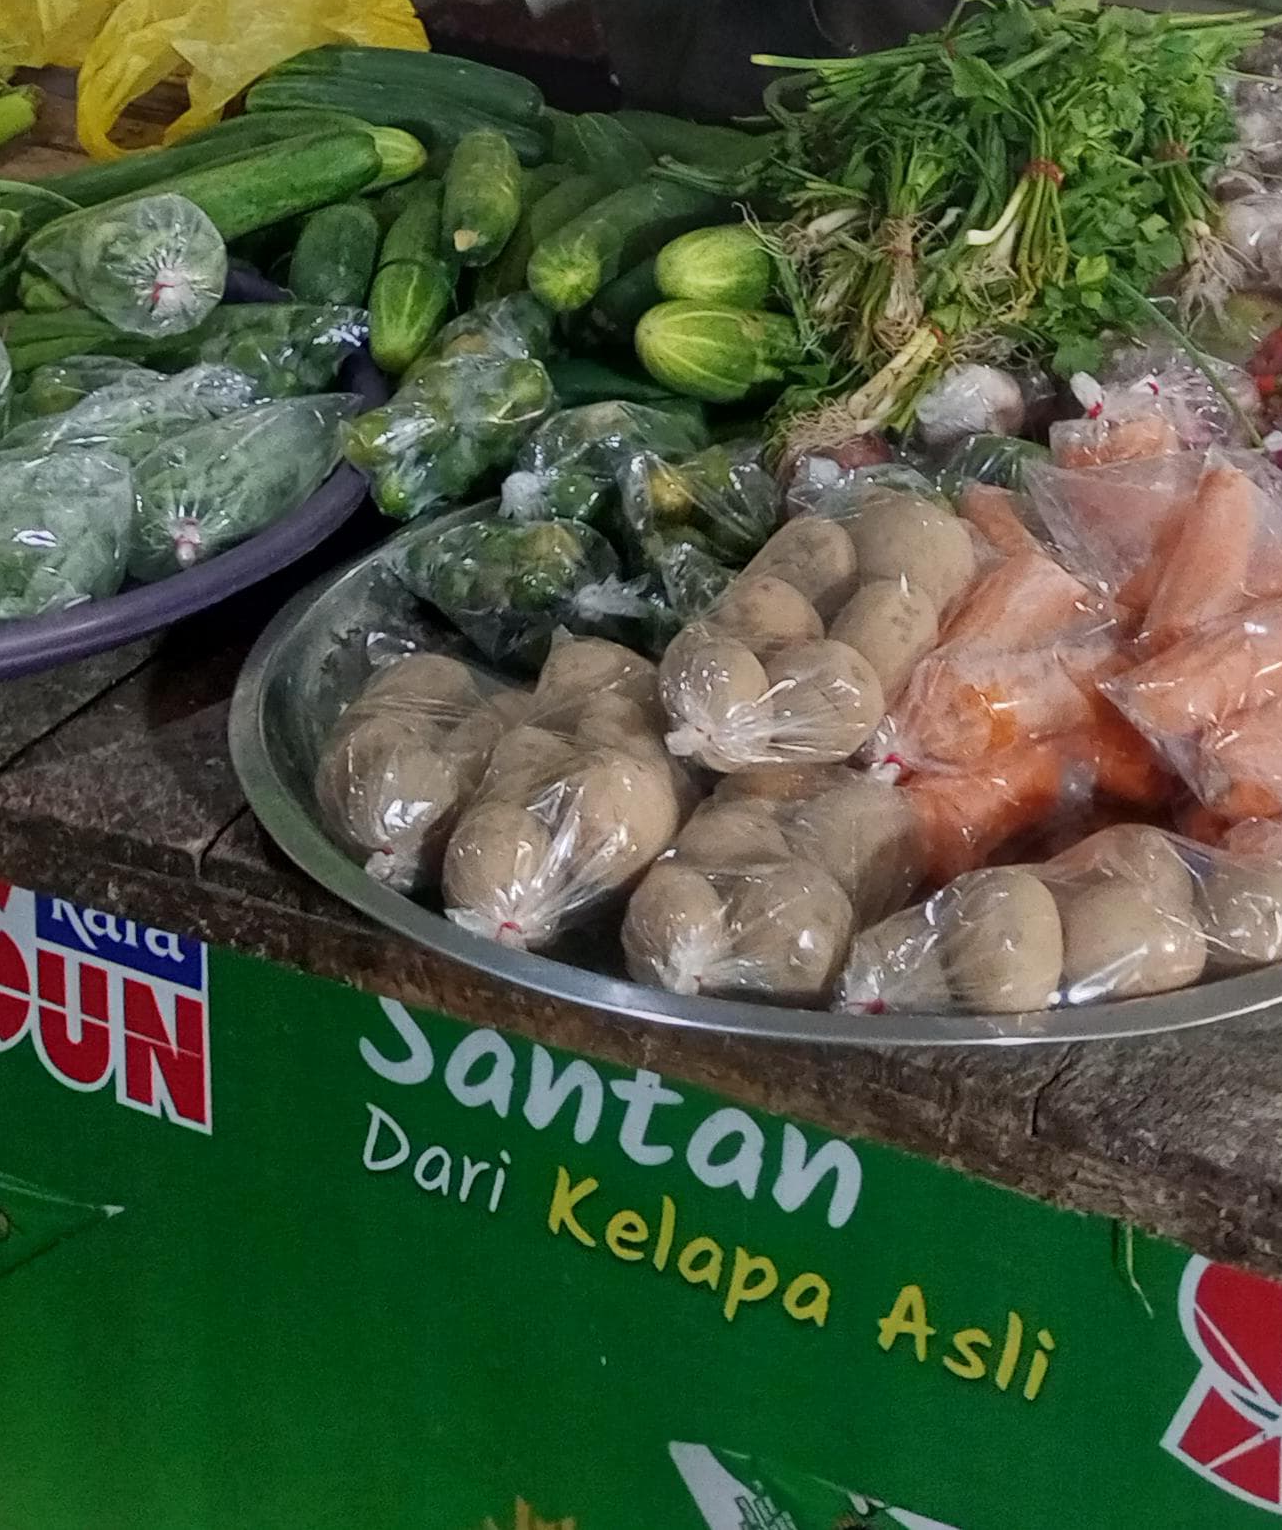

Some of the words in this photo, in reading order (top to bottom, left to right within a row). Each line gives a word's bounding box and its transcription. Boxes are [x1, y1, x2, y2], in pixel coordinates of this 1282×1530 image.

[360, 1103, 510, 1212] Dari
[547, 1167, 831, 1327] Kelapa
[877, 1284, 1056, 1400] Asli
